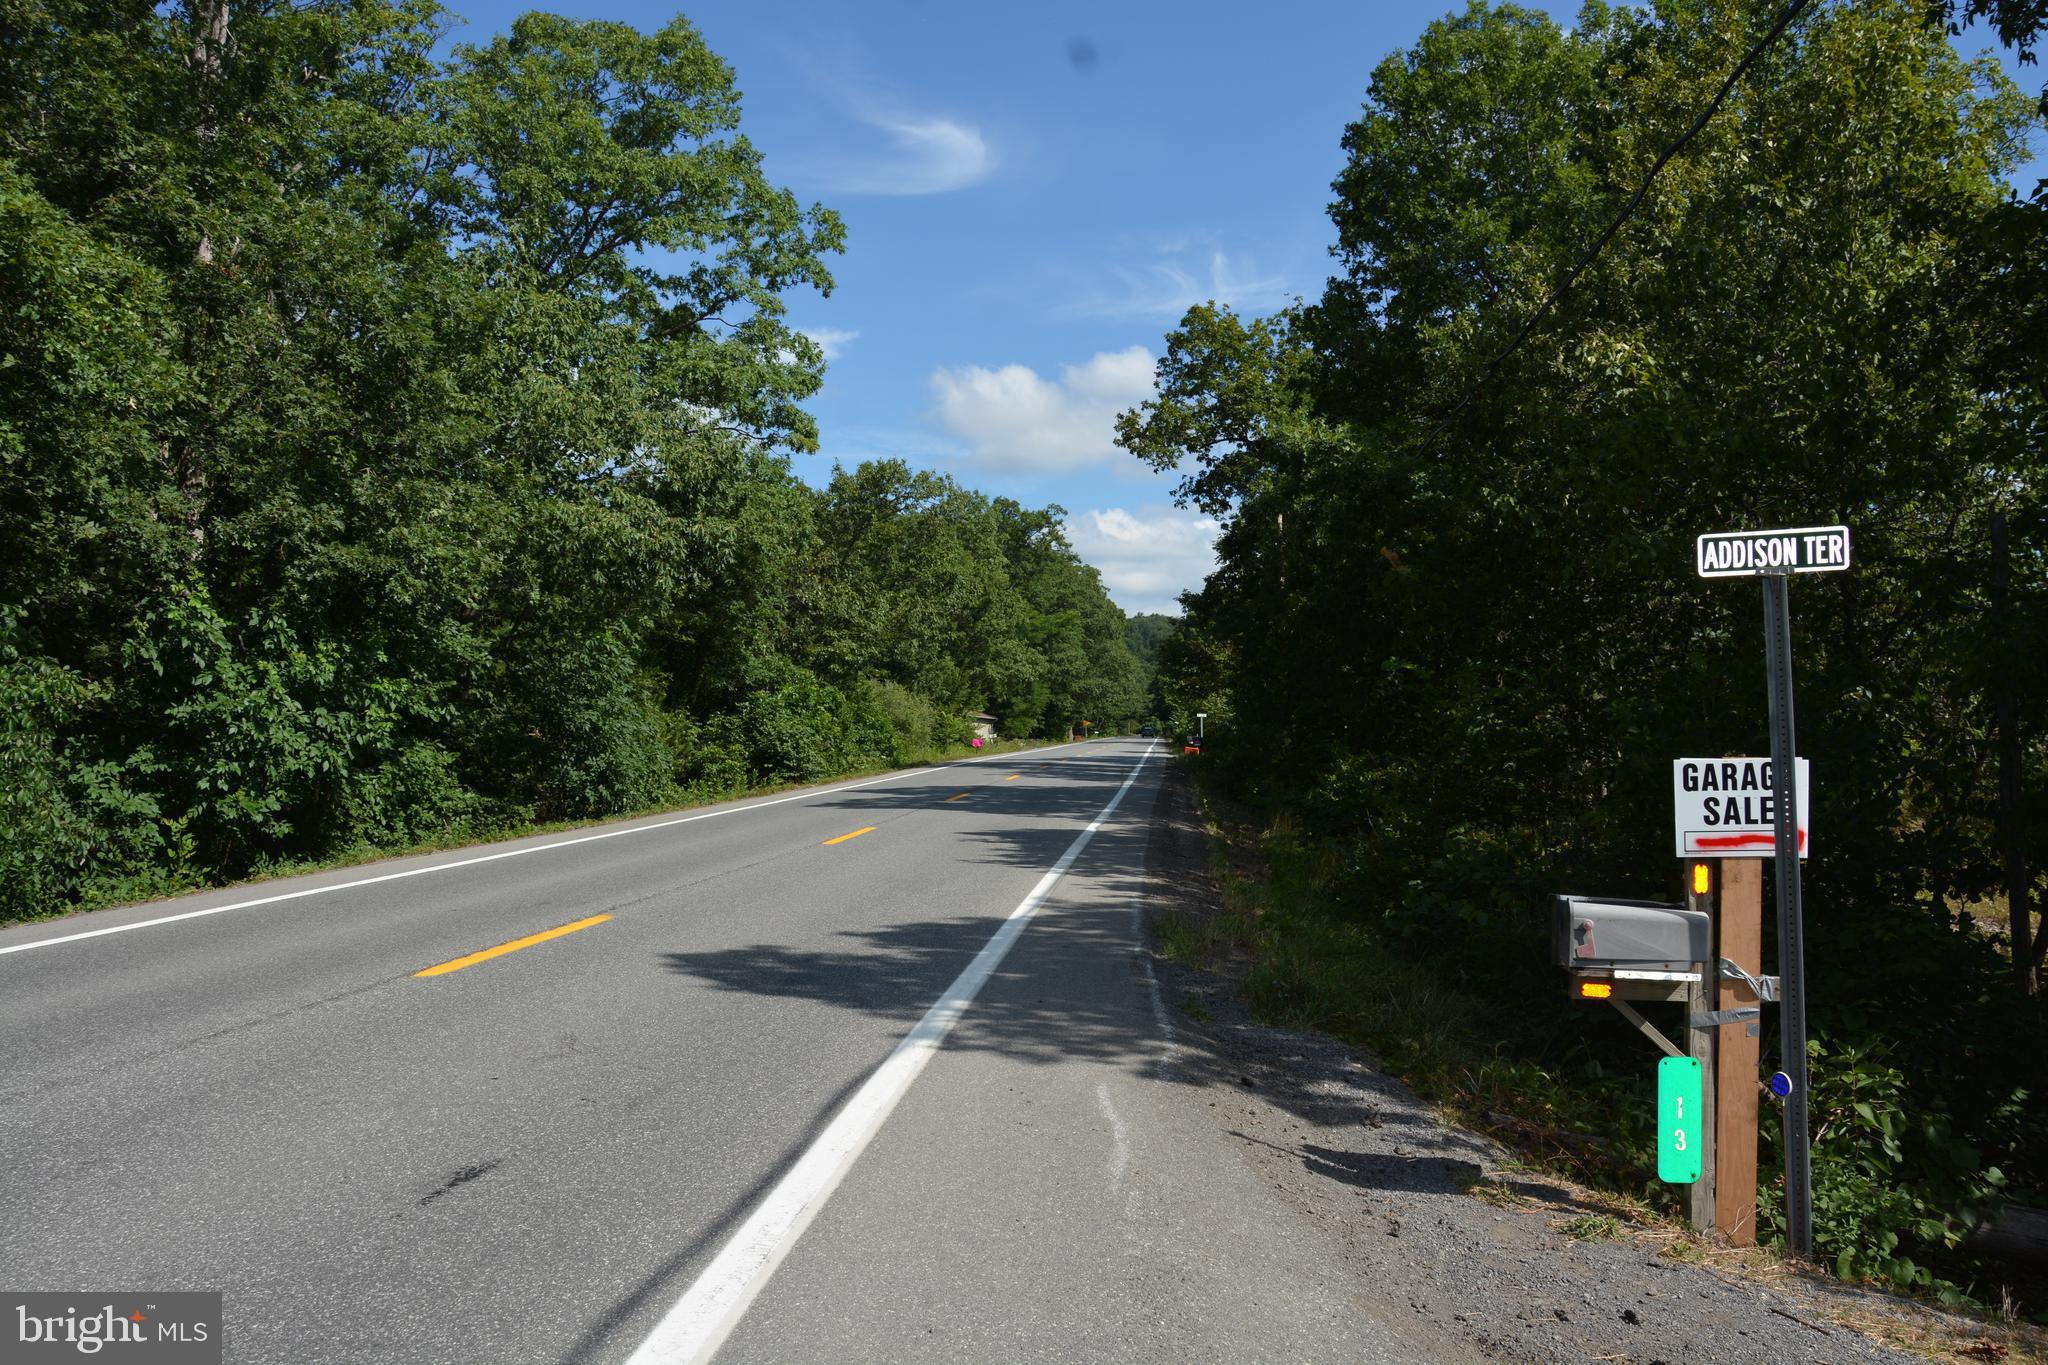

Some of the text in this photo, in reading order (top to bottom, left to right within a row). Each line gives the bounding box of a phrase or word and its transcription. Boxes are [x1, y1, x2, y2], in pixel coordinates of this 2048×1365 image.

[1703, 535, 1843, 570] ADDISON TER
[1682, 762, 1773, 792] GARAG
[1703, 796, 1775, 826] SALE
